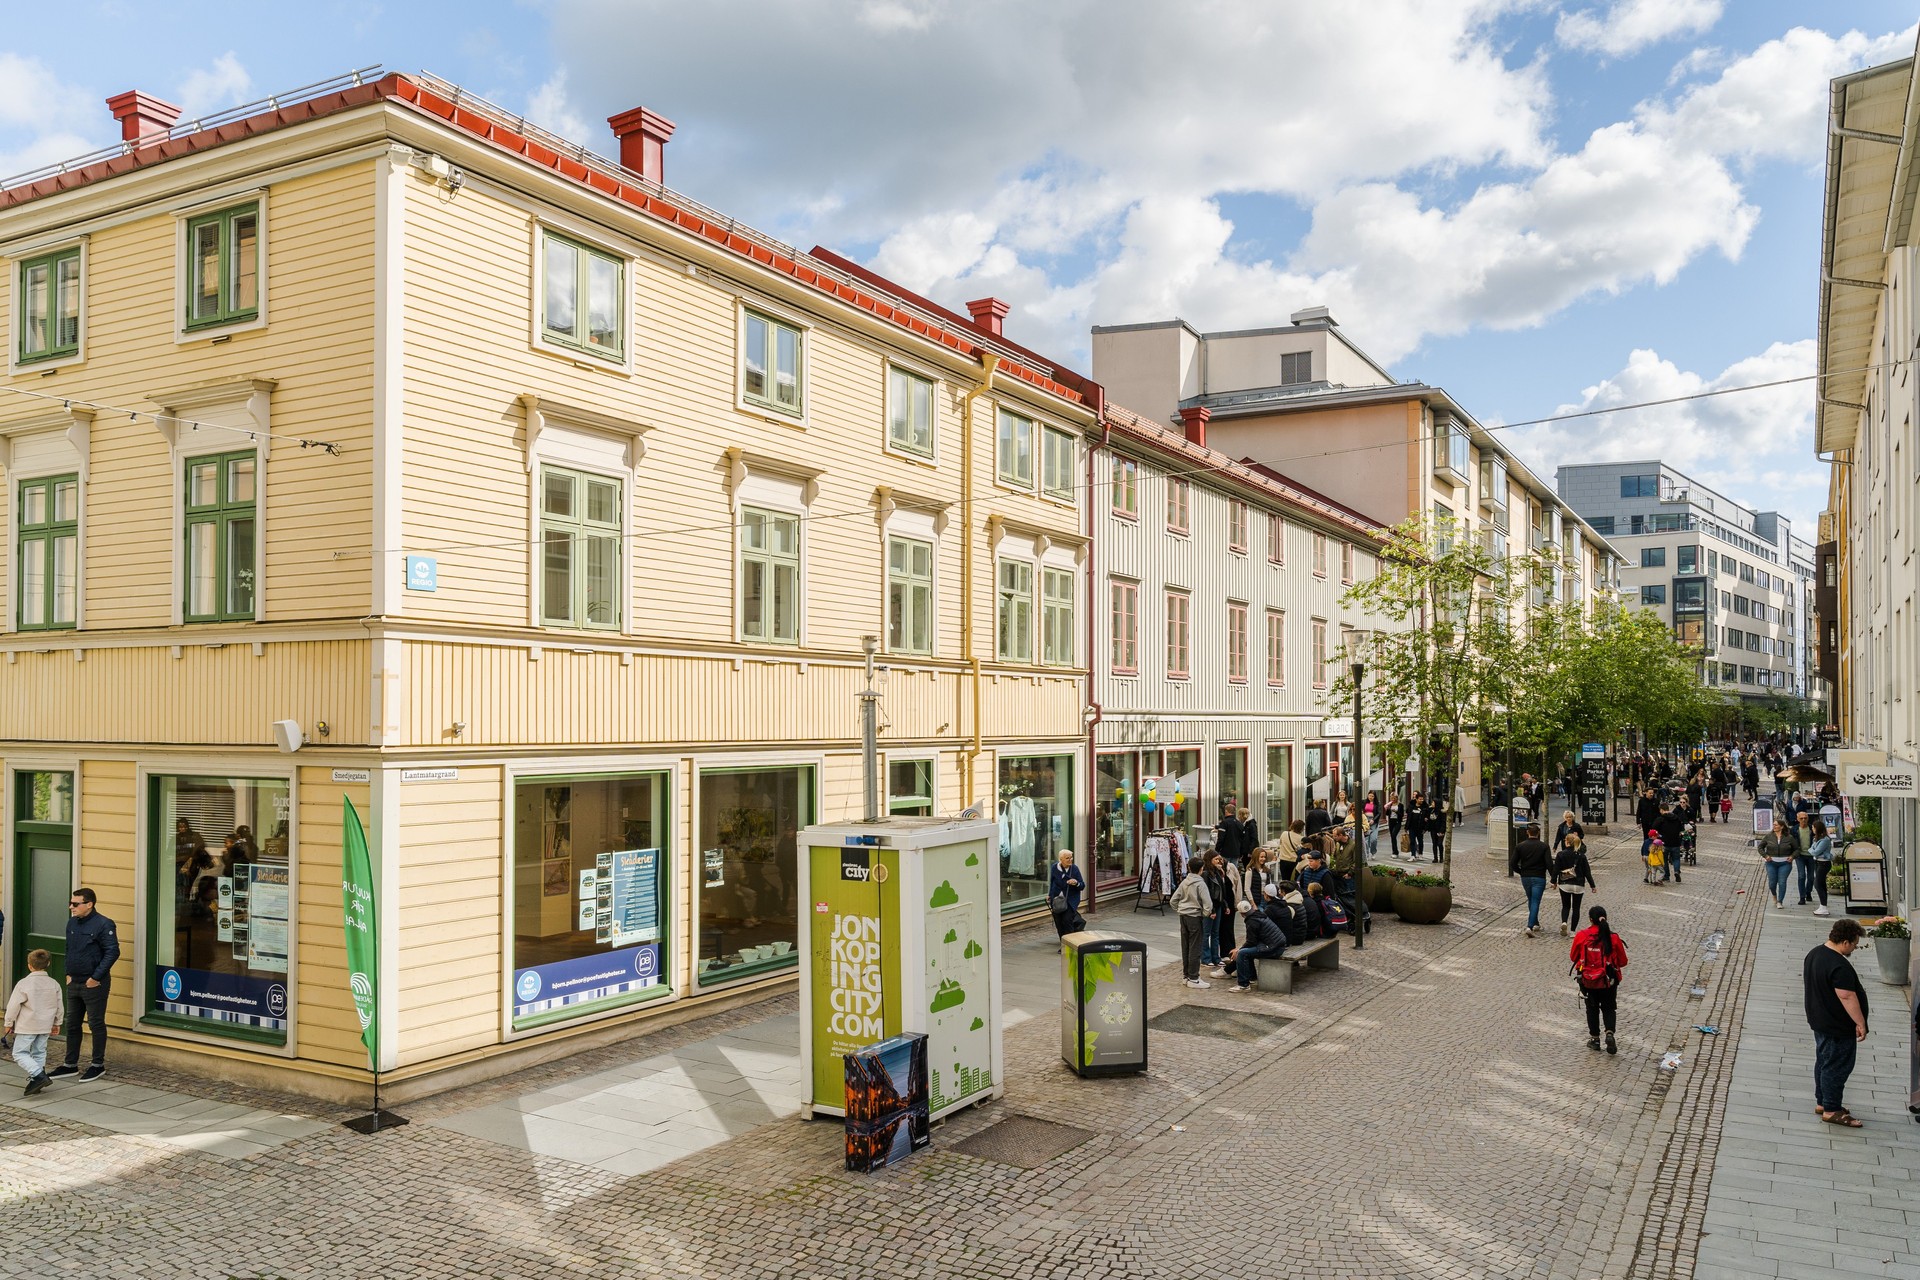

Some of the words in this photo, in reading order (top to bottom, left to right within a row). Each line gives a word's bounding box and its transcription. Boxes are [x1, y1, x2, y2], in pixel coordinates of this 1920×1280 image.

[334, 771, 367, 780] Smedjegatan
[830, 914, 881, 943] JON
[830, 938, 881, 964] KOP
[831, 961, 882, 993] ING
[830, 988, 882, 1016] CITY
[826, 1012, 884, 1040] .COM
